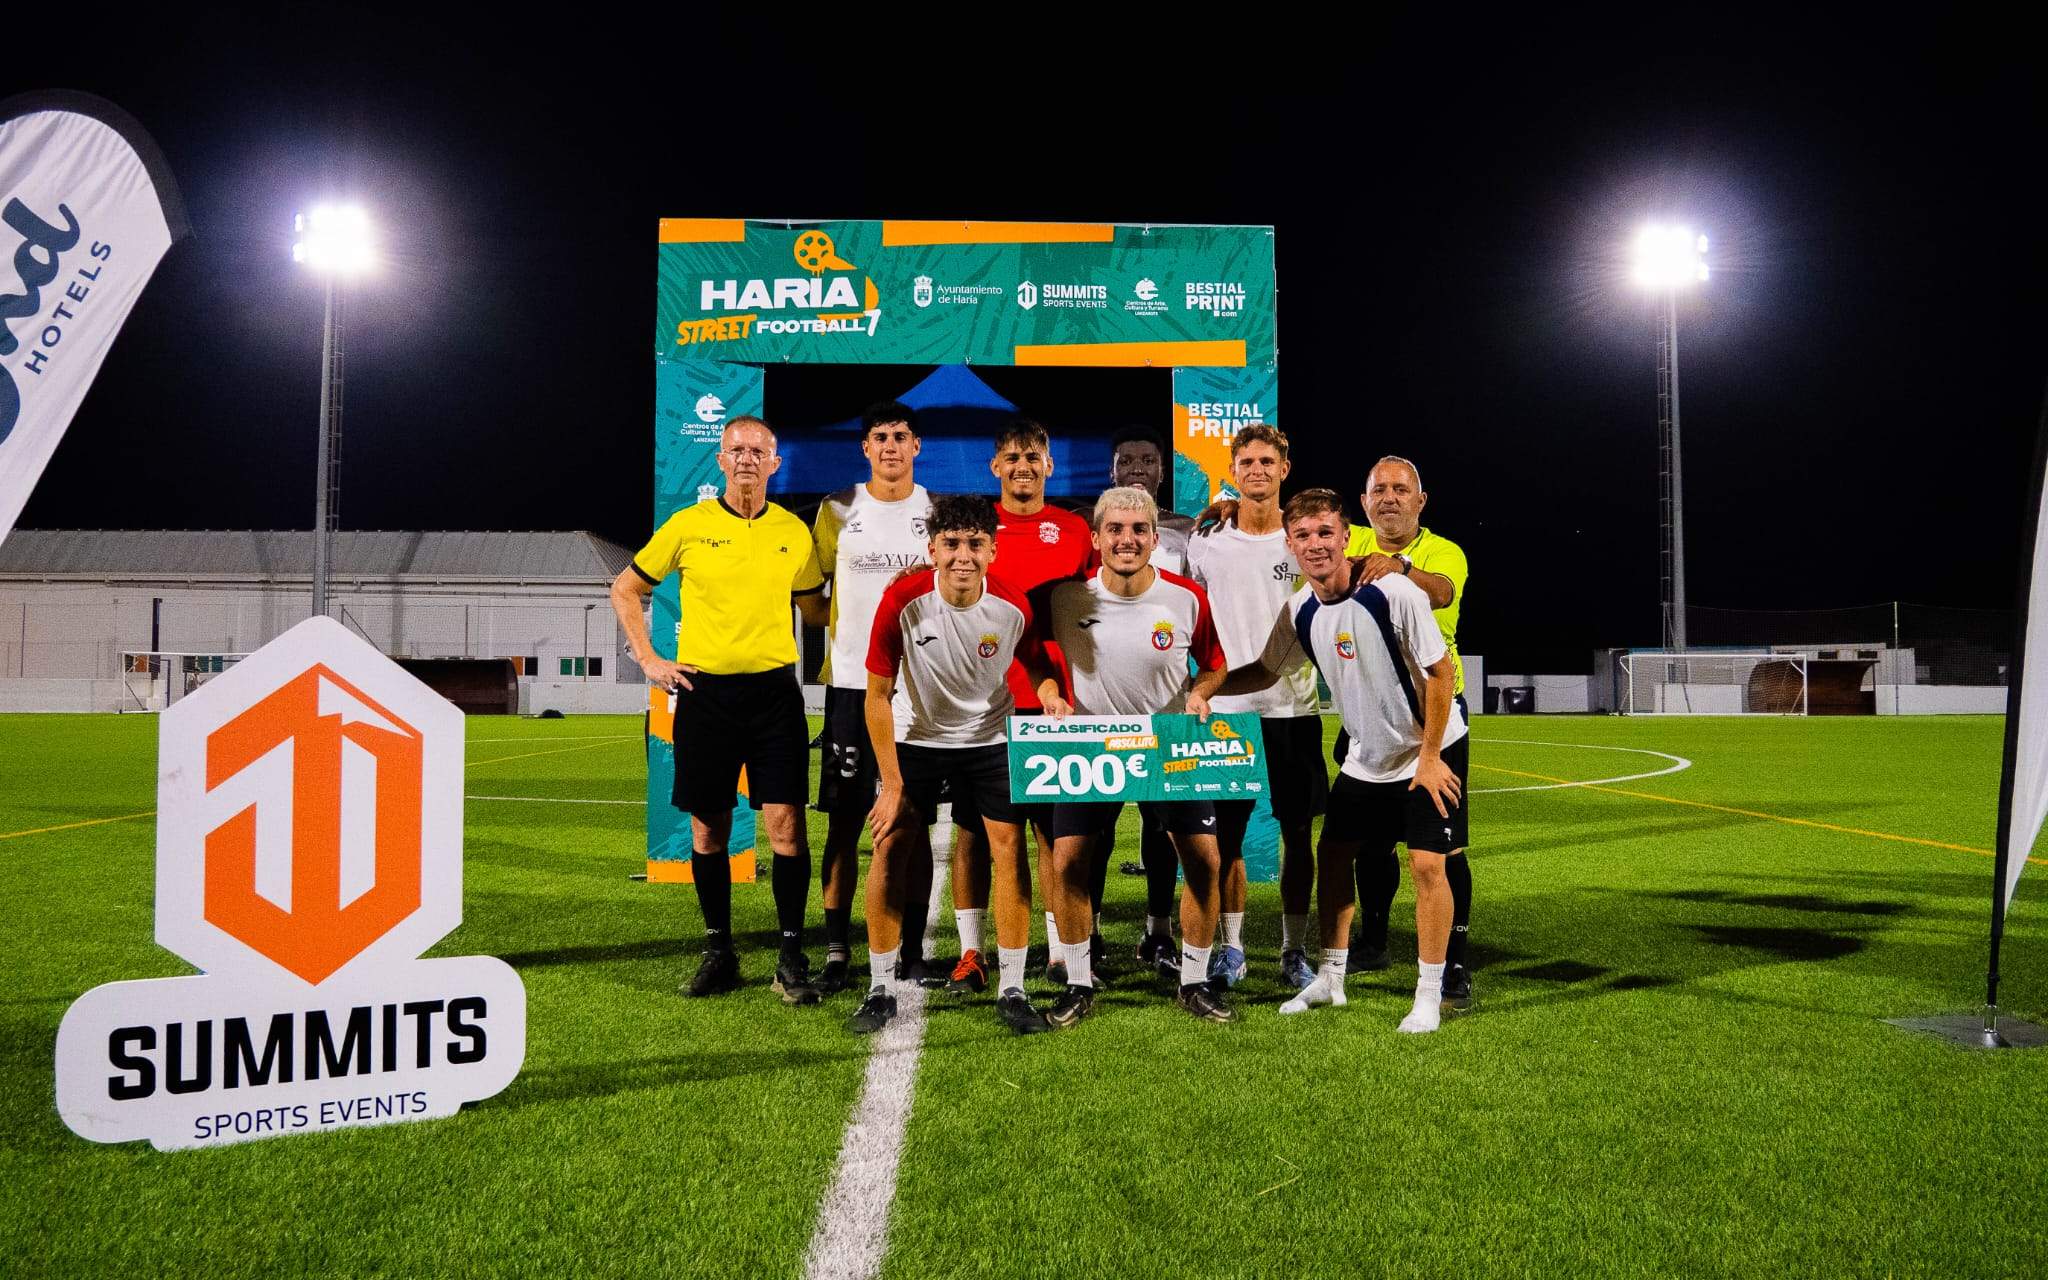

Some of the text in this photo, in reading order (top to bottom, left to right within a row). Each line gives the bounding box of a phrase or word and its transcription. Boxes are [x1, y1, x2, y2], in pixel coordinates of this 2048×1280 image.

[936, 284, 1003, 296] Ayuntamiento
[1043, 284, 1107, 299] SUMMITS
[1186, 282, 1246, 294] BESTIAL
[938, 295, 951, 304] de
[1043, 299, 1107, 309] SPORTS EVENTS
[24, 241, 112, 375] HOTELS
[676, 314, 757, 345] STREET
[1188, 403, 1264, 418] BESTIAL
[1036, 724, 1143, 734] CLASIFICADO
[1163, 758, 1199, 775] STREET
[1024, 753, 1149, 796] 200€
[108, 996, 487, 1102] SUMMITS
[194, 1091, 428, 1140] SPORTS EVENTS
